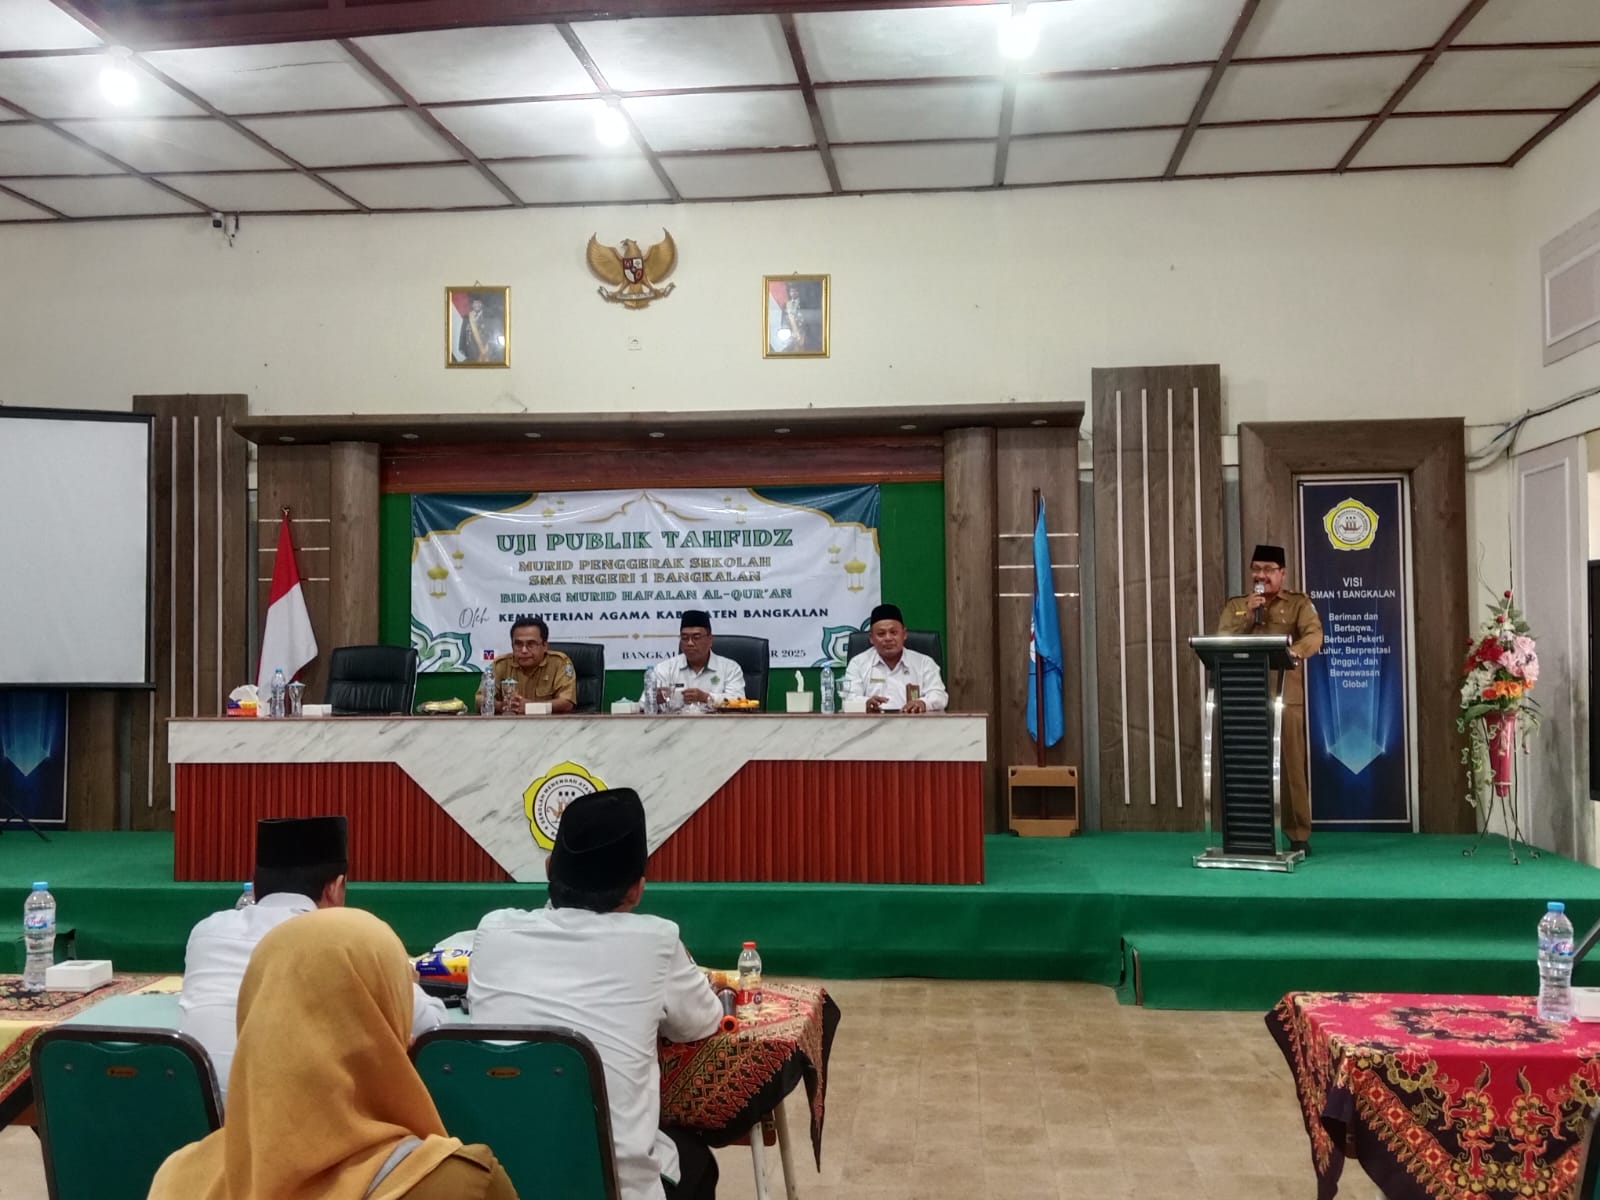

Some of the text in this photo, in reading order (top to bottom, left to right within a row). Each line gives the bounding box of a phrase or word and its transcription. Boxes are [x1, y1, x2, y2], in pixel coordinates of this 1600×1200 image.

[496, 529, 793, 555] UJI PUBLIK TAHFIDZ
[518, 556, 771, 572] MURID PENGGERAK SEKOLAH
[528, 571, 761, 586] SMA NEGERI 1 BANGKALAN
[1342, 577, 1363, 587] VISI
[500, 592, 561, 604] BIDANG
[566, 591, 617, 602] MURID
[622, 590, 697, 601] HAFALAN
[1310, 589, 1396, 599] SMAN 1 BANGKALAN
[600, 611, 650, 620] AGAMA
[656, 609, 737, 619] KABATEN
[743, 608, 828, 618] BANGKALAN
[1328, 611, 1379, 621] Beriman dan
[1323, 634, 1385, 644] Berbudi Pekerti
[781, 649, 807, 659] 2025
[1345, 645, 1391, 656] Berprestasi
[1363, 656, 1379, 666] dan
[1329, 668, 1380, 677] Berwawasan
[1342, 679, 1368, 688] Global
